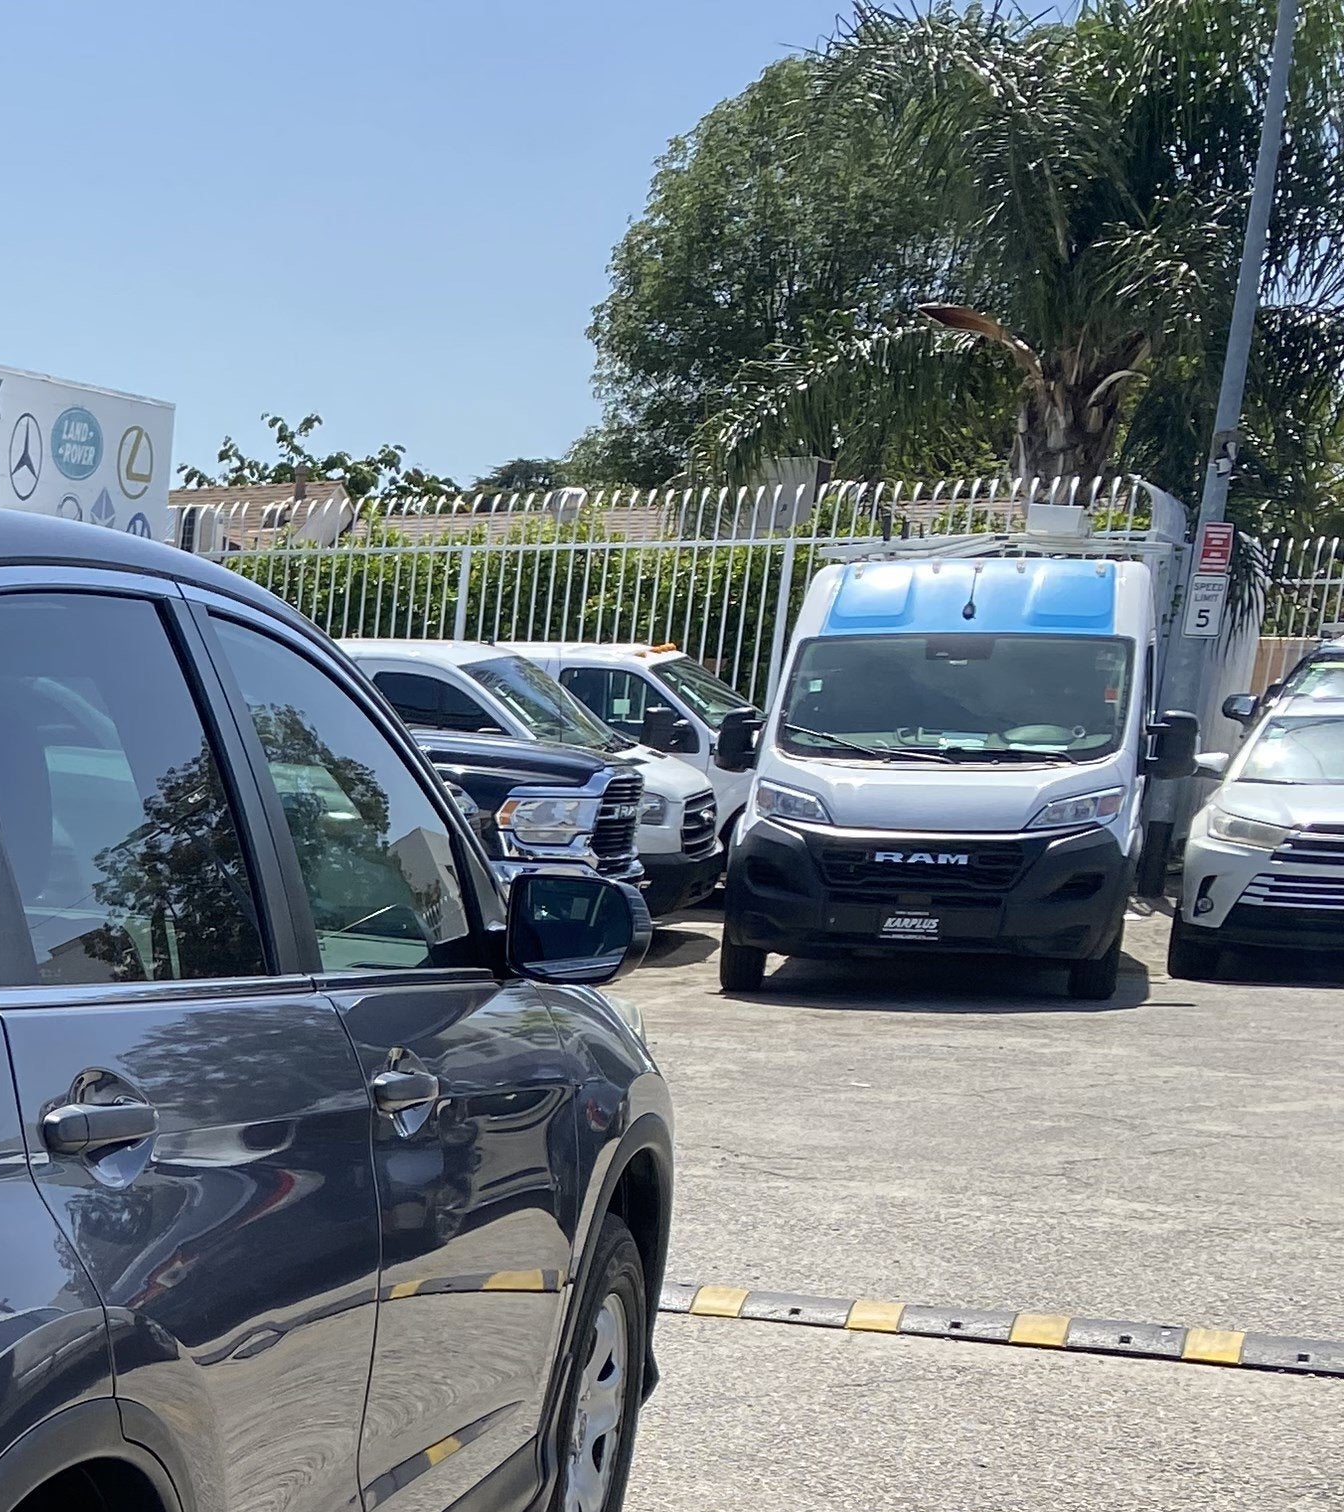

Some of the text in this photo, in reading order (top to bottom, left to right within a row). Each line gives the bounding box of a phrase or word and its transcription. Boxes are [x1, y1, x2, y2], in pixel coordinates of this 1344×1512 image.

[63, 419, 89, 443] LAND
[62, 444, 96, 467] ROVER
[1193, 582, 1224, 592] SPEED
[1194, 593, 1220, 603] LIMIT
[1195, 608, 1211, 628] 5
[875, 852, 969, 865] RAM
[883, 917, 939, 928] KARPLUS
